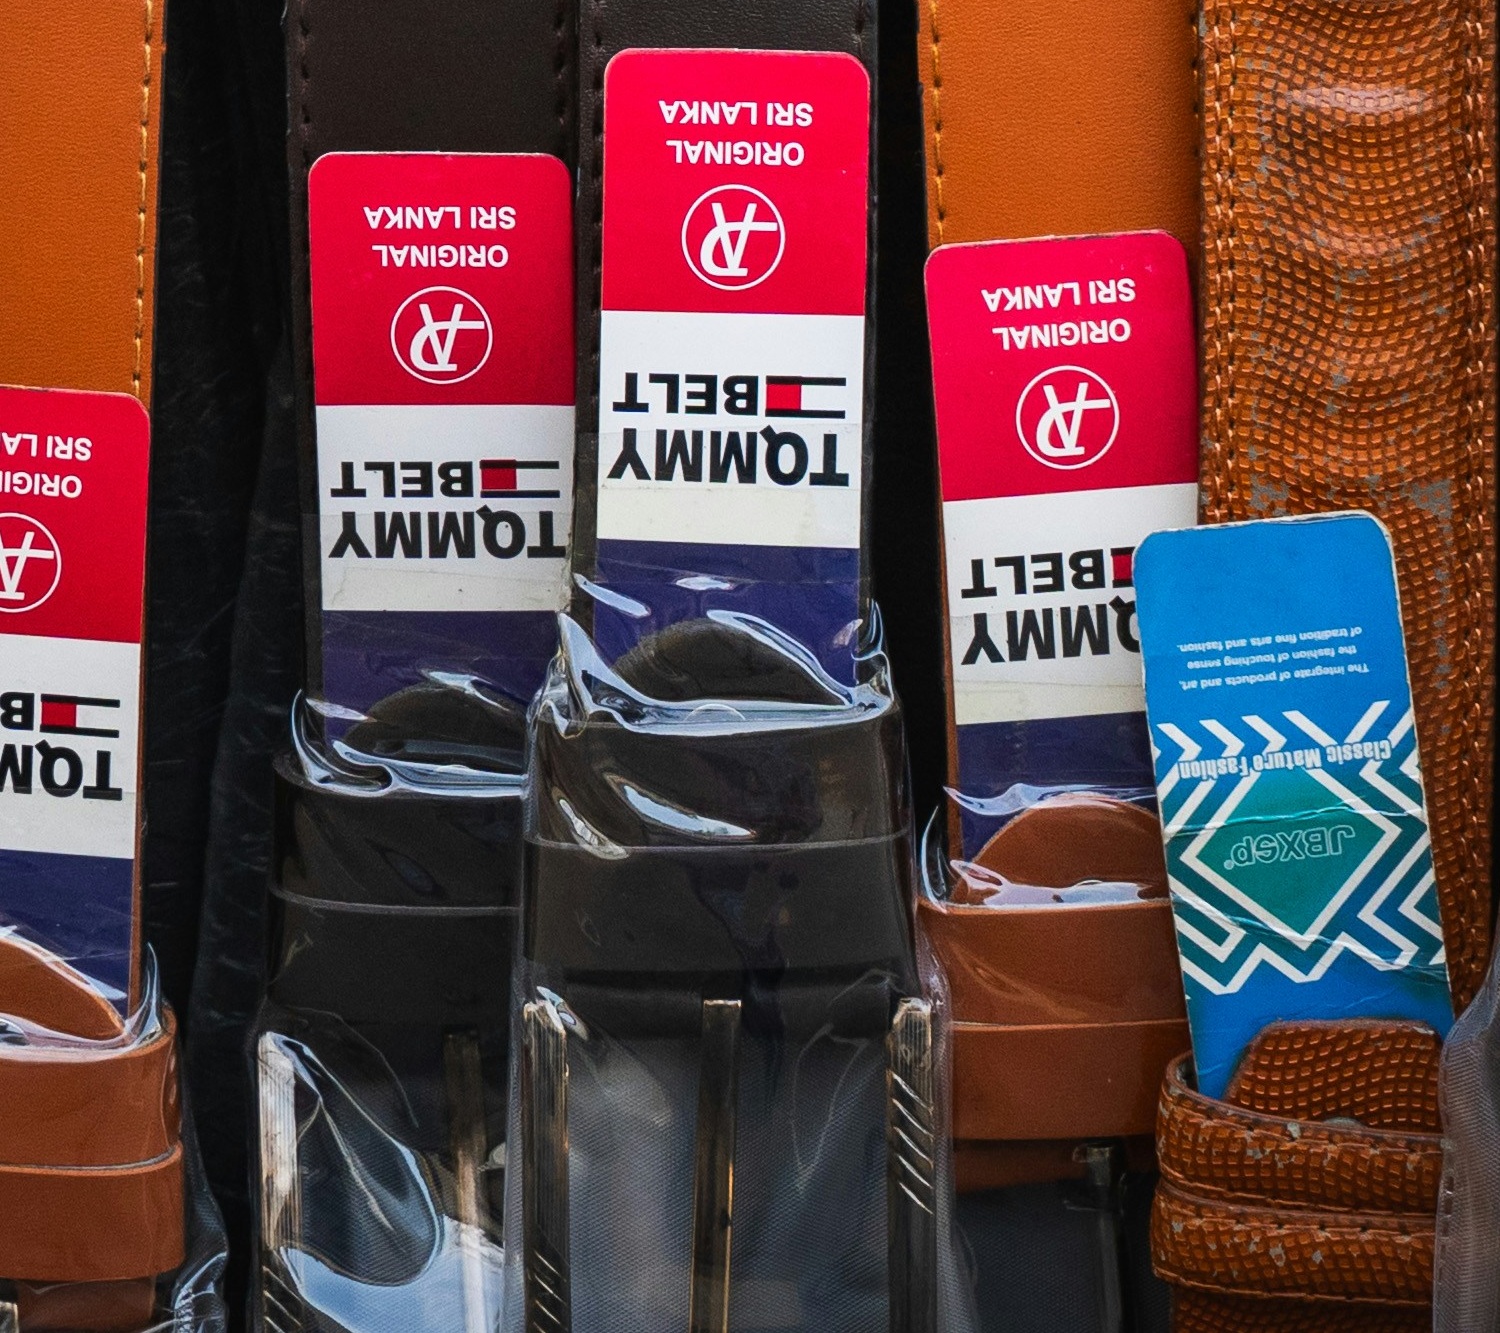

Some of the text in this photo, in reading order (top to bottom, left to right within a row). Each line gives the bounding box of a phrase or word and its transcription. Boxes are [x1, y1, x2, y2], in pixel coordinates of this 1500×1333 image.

[658, 99, 814, 127] SRI LANKA
[666, 139, 806, 166] ORIGINAL
[362, 205, 517, 231] SRI LANKA
[371, 244, 509, 269] ORIGINAL
[980, 276, 1137, 313] SRI LANKA
[991, 317, 1132, 350] ORIGINAL
[612, 372, 765, 415] BELT
[44, 431, 94, 463] SRI
[329, 459, 474, 499] BELT
[959, 549, 1101, 599] BELT
[1250, 636, 1272, 647] arts
[1275, 633, 1297, 645] fine
[1298, 629, 1348, 642] tradition
[1350, 626, 1363, 637] of
[1225, 639, 1247, 650] and
[1187, 645, 1357, 670] the fashion of touching sense
[1347, 662, 1369, 673] The
[1201, 678, 1223, 689] and
[1224, 671, 1277, 686] products
[1279, 670, 1291, 681] of
[1294, 664, 1345, 679] integrate
[1177, 739, 1392, 780] Classic Mature Fashion
